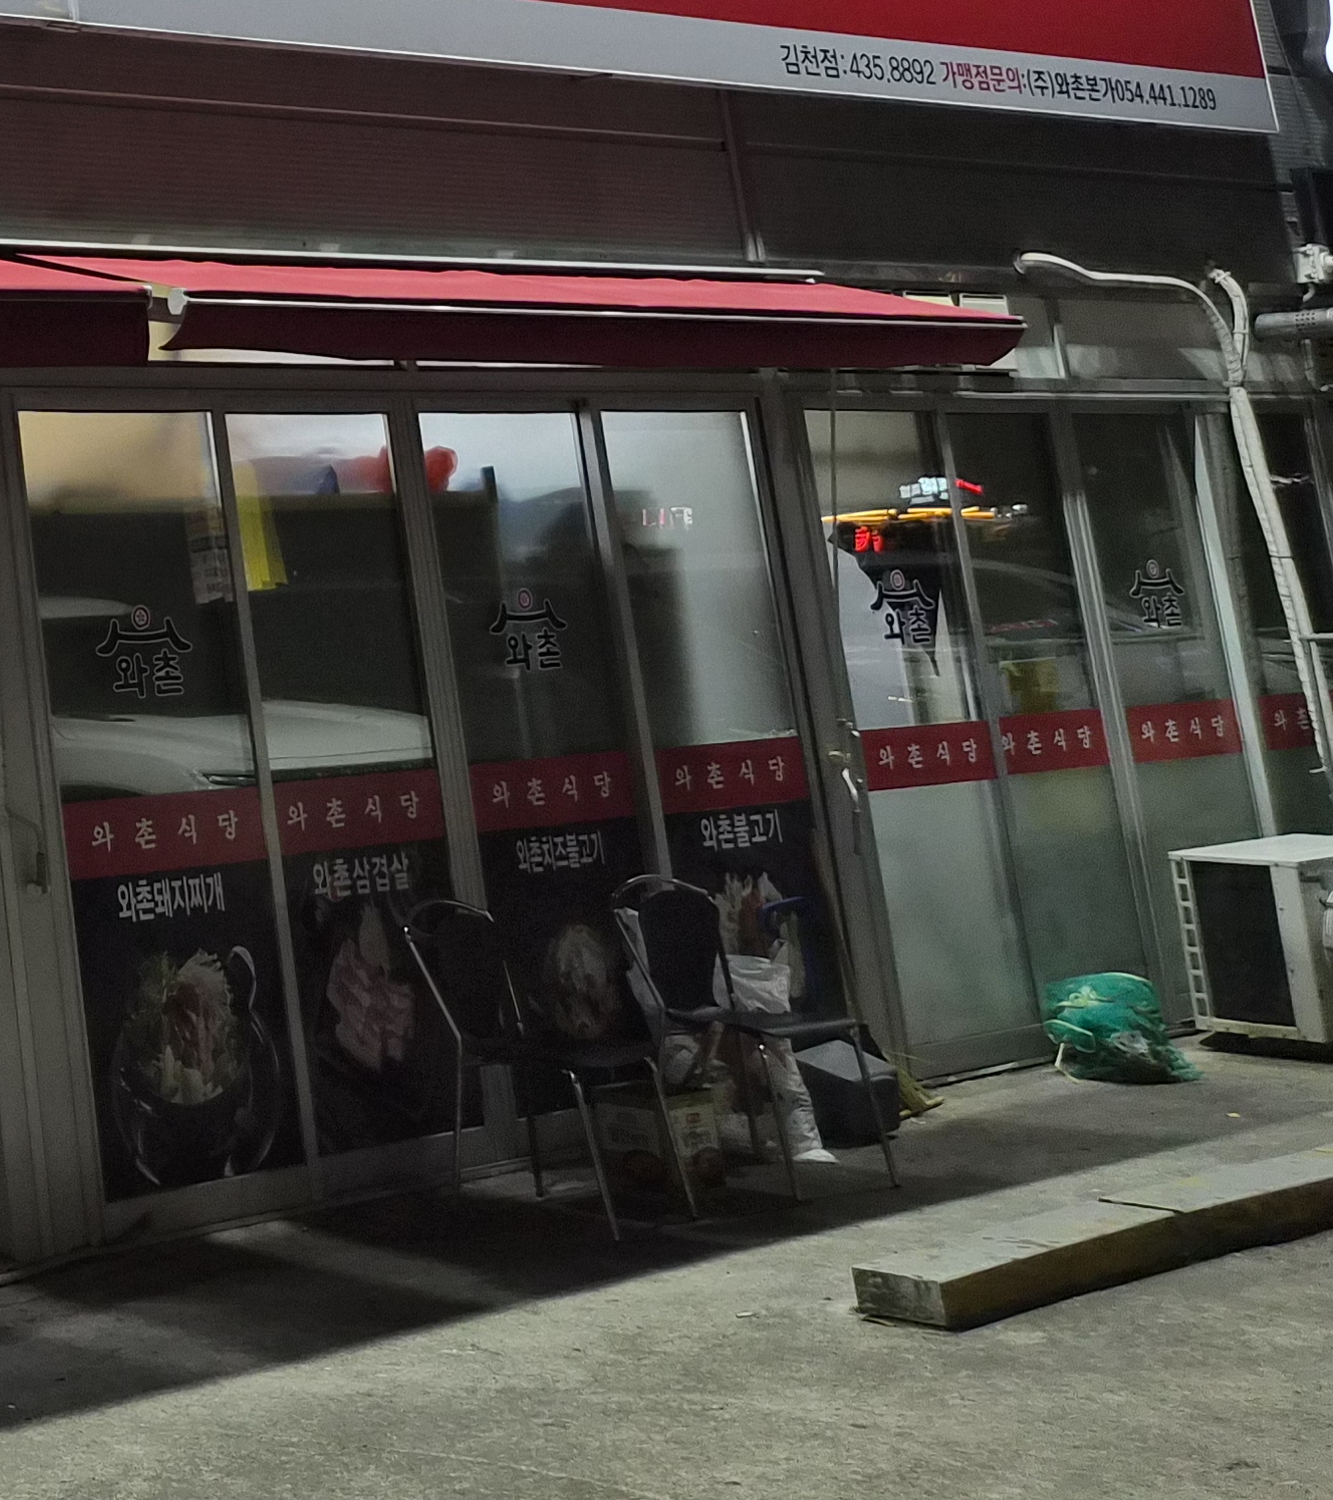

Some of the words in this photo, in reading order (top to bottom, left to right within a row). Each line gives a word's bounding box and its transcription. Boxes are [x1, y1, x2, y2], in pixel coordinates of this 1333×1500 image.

[505, 632, 562, 672] 와촌
[112, 650, 185, 698] 와촌
[1141, 715, 1225, 743] 와촌식당
[674, 754, 787, 791] 와촌식당
[877, 735, 978, 770] 와촌식당
[490, 770, 613, 810] 와촌식당
[91, 808, 240, 853] 와촌식당
[285, 791, 421, 831] 와촌식당
[515, 830, 606, 871] 와촌치즈불고기
[699, 811, 784, 852] 와촌불고기
[116, 872, 226, 923] 와촌돼지찌개
[312, 853, 410, 902] 와촌삼겹살
